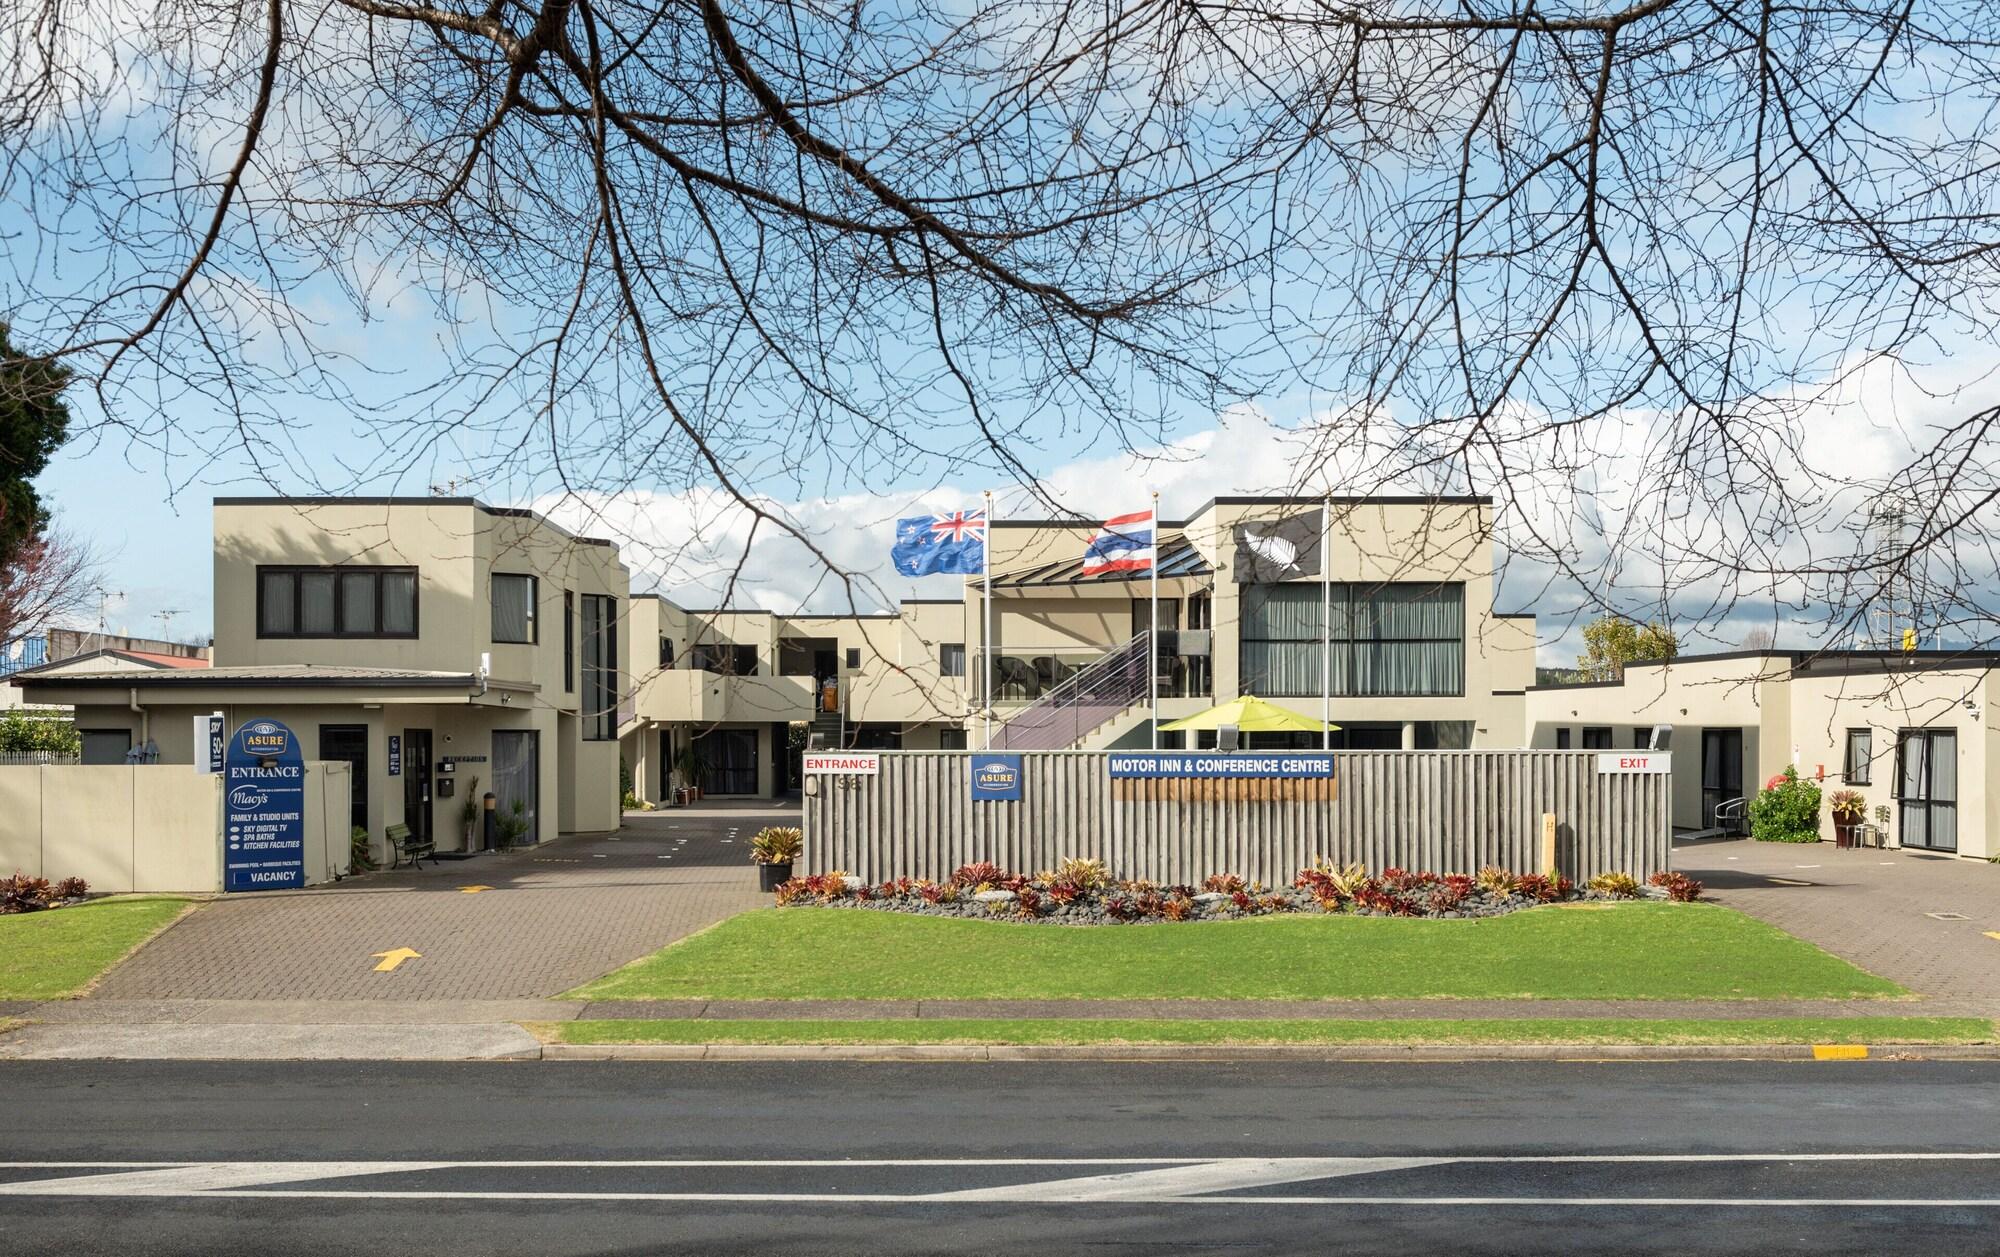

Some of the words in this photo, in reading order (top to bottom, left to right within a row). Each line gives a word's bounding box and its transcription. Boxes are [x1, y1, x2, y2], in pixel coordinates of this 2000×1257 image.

[247, 736, 284, 745] ASURE
[806, 759, 876, 769] ENTRANCE
[1111, 759, 1157, 772] MOTOR
[1160, 759, 1181, 772] INN
[1184, 759, 1193, 772] &
[1196, 759, 1278, 772] CONFERENCE
[1281, 759, 1330, 772] CENTRE
[1619, 758, 1649, 768] EXIT
[231, 766, 300, 778] ENTRANCE
[980, 774, 1014, 782] ASURE
[230, 814, 252, 822] FAMILY
[253, 813, 258, 821] &
[259, 813, 281, 821] STUDIO
[282, 812, 299, 820] UNITS
[243, 825, 256, 833] SKY
[243, 833, 255, 841] SPA
[243, 842, 269, 850] KITCHEN
[269, 841, 300, 849] FACILITIES
[250, 871, 297, 883] VACANCY
